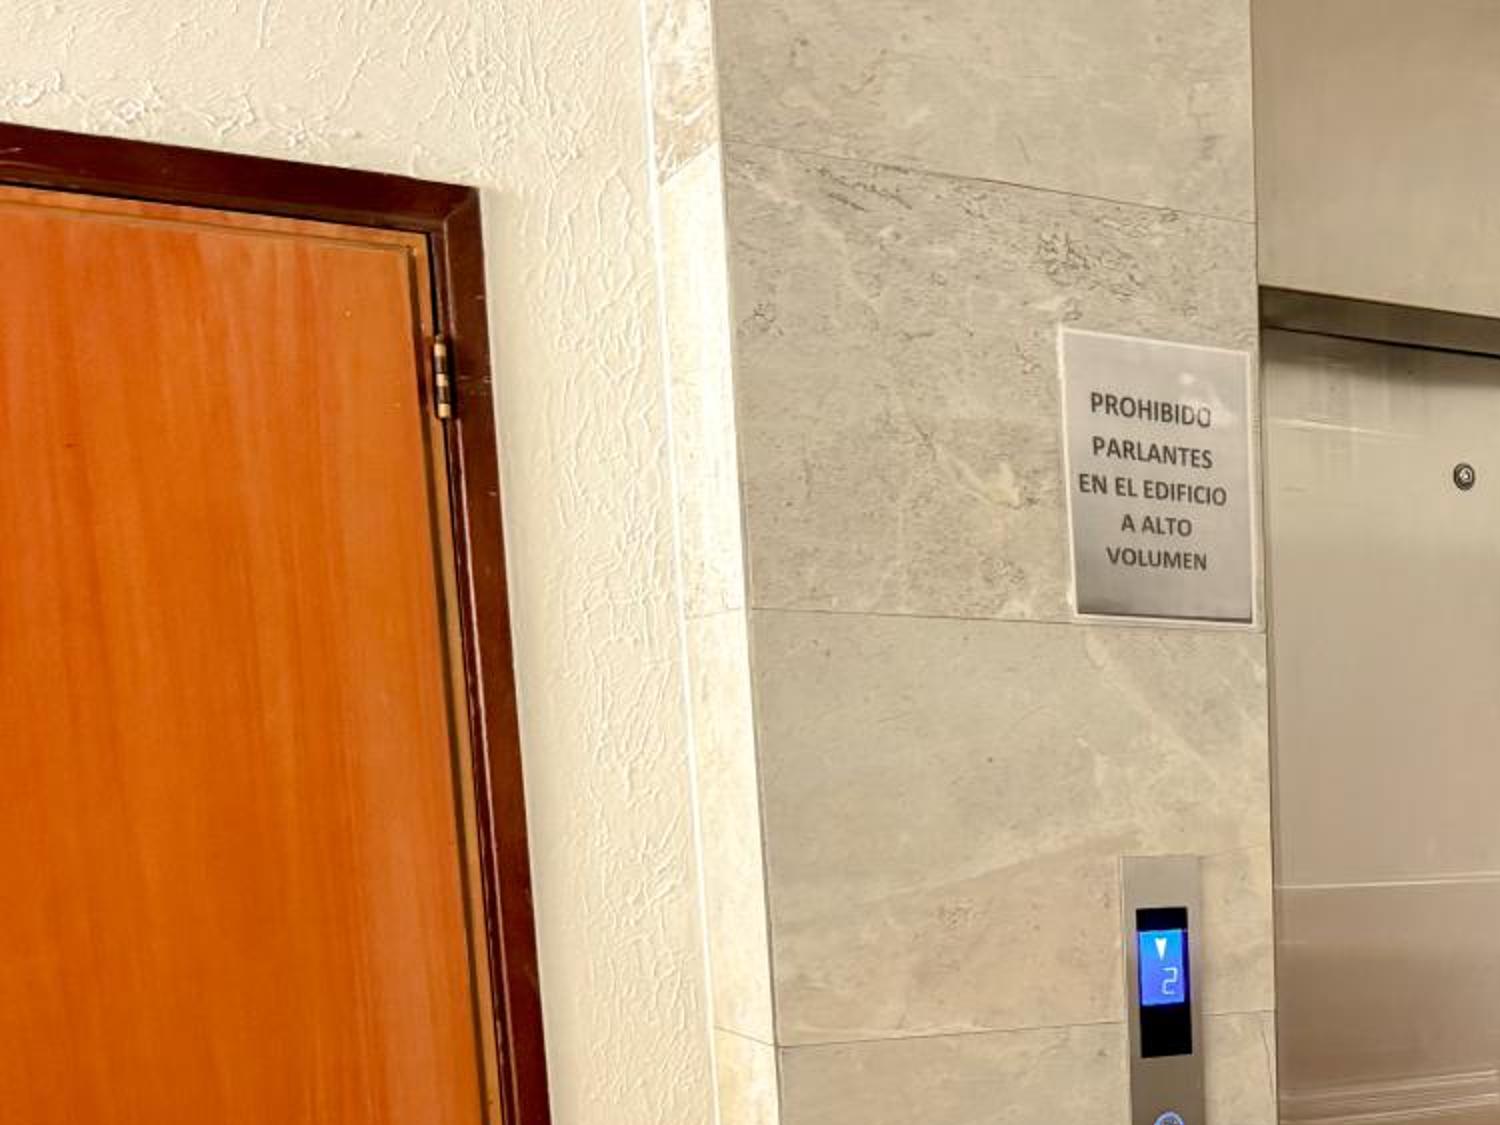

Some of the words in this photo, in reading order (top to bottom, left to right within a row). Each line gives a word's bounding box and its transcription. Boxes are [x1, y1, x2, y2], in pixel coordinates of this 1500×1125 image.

[1091, 392, 1211, 428] PROHIBIDO
[1092, 436, 1213, 469] PARLANTES
[1079, 473, 1107, 494] EN
[1115, 477, 1138, 497] EL
[1144, 481, 1227, 506] EDIFICIO
[1121, 514, 1136, 533] A
[1141, 516, 1192, 537] ALTO
[1107, 547, 1207, 571] VOLUMEN
[1162, 967, 1178, 995] 2
